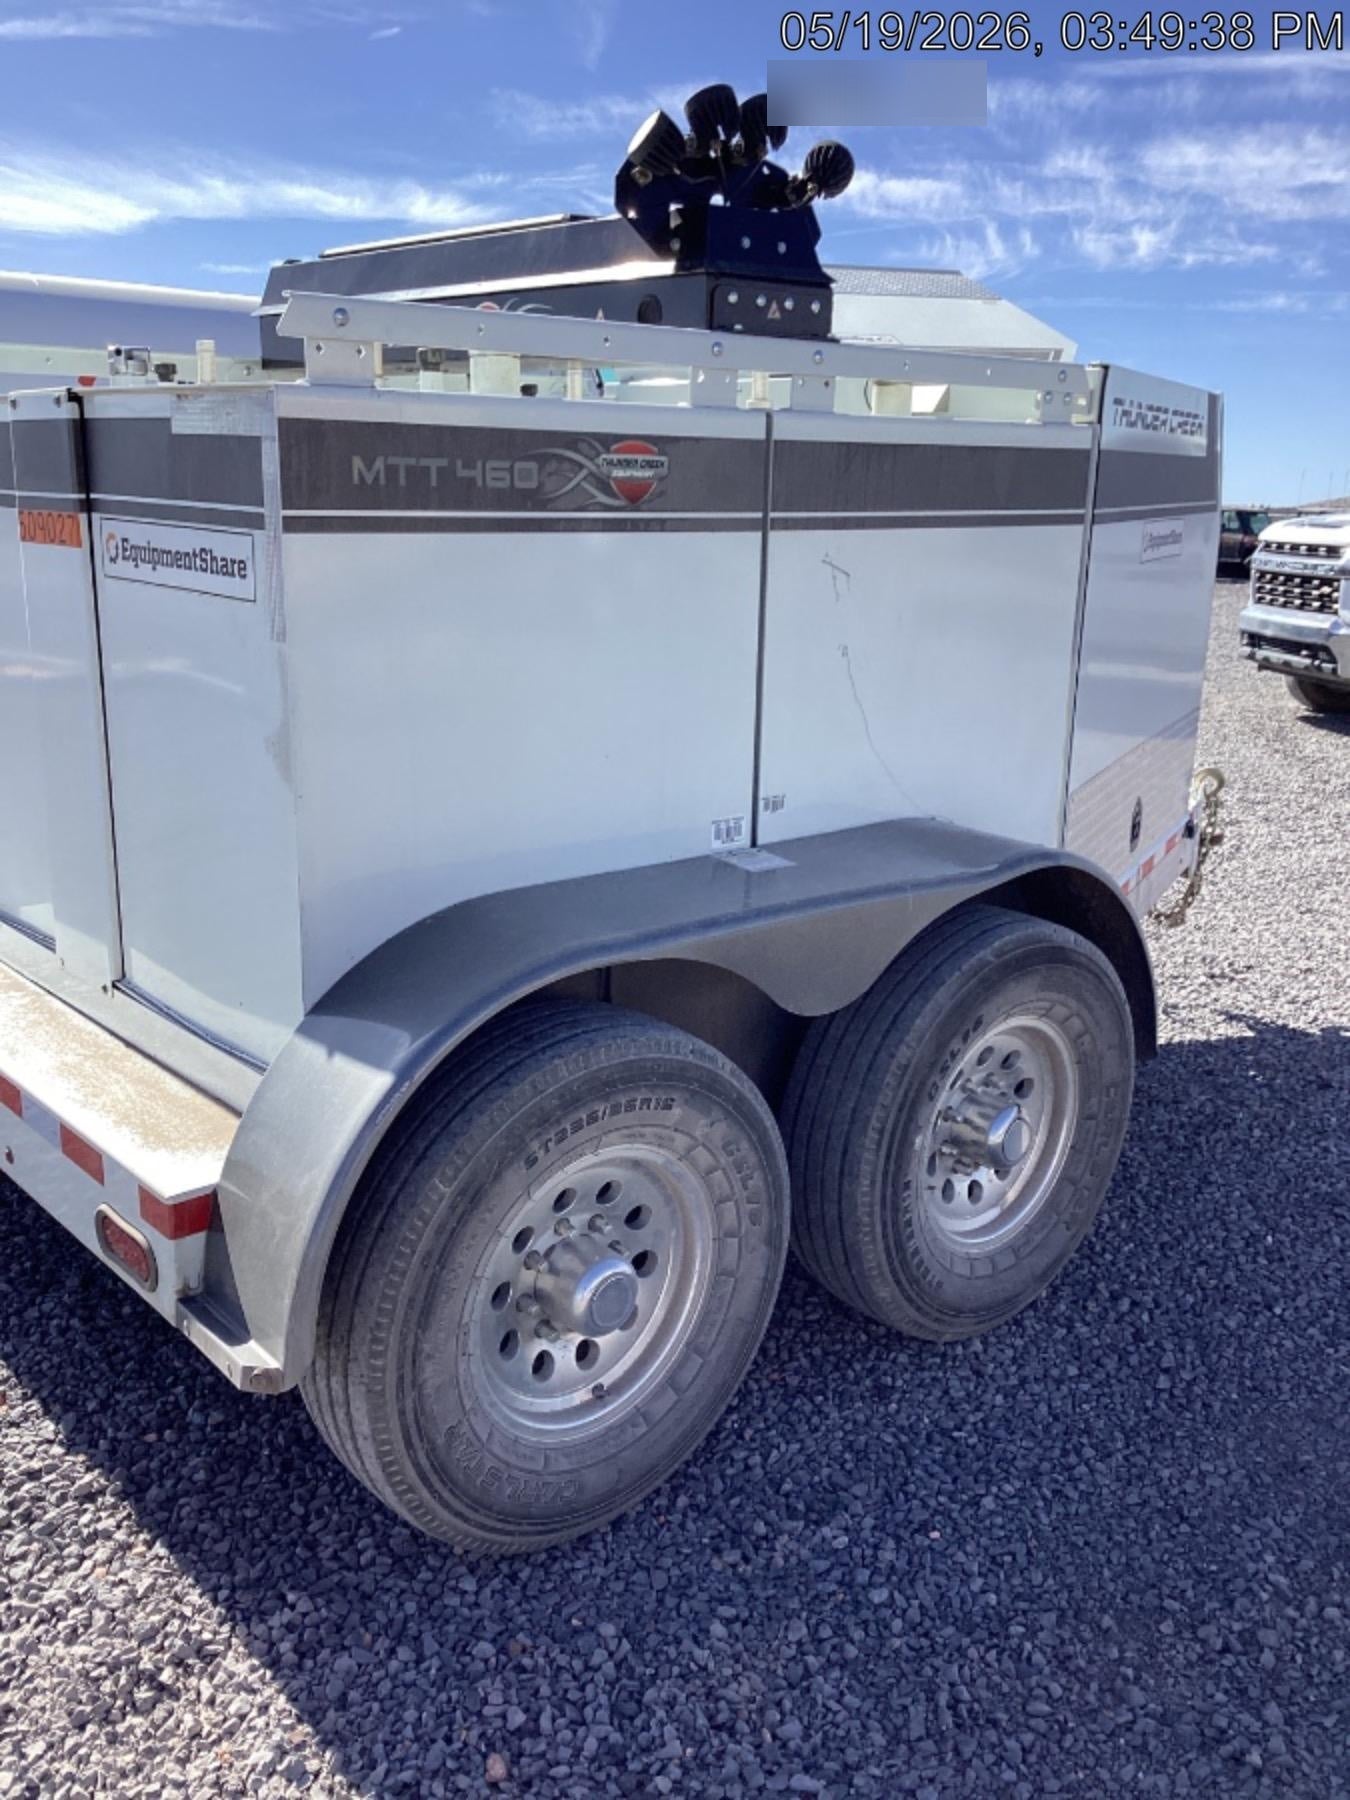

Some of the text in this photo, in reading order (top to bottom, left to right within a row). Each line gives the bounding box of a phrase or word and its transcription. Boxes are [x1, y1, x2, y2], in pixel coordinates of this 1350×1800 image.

[352, 456, 538, 489] MTT 460
[121, 537, 248, 580] EquipmentShare
